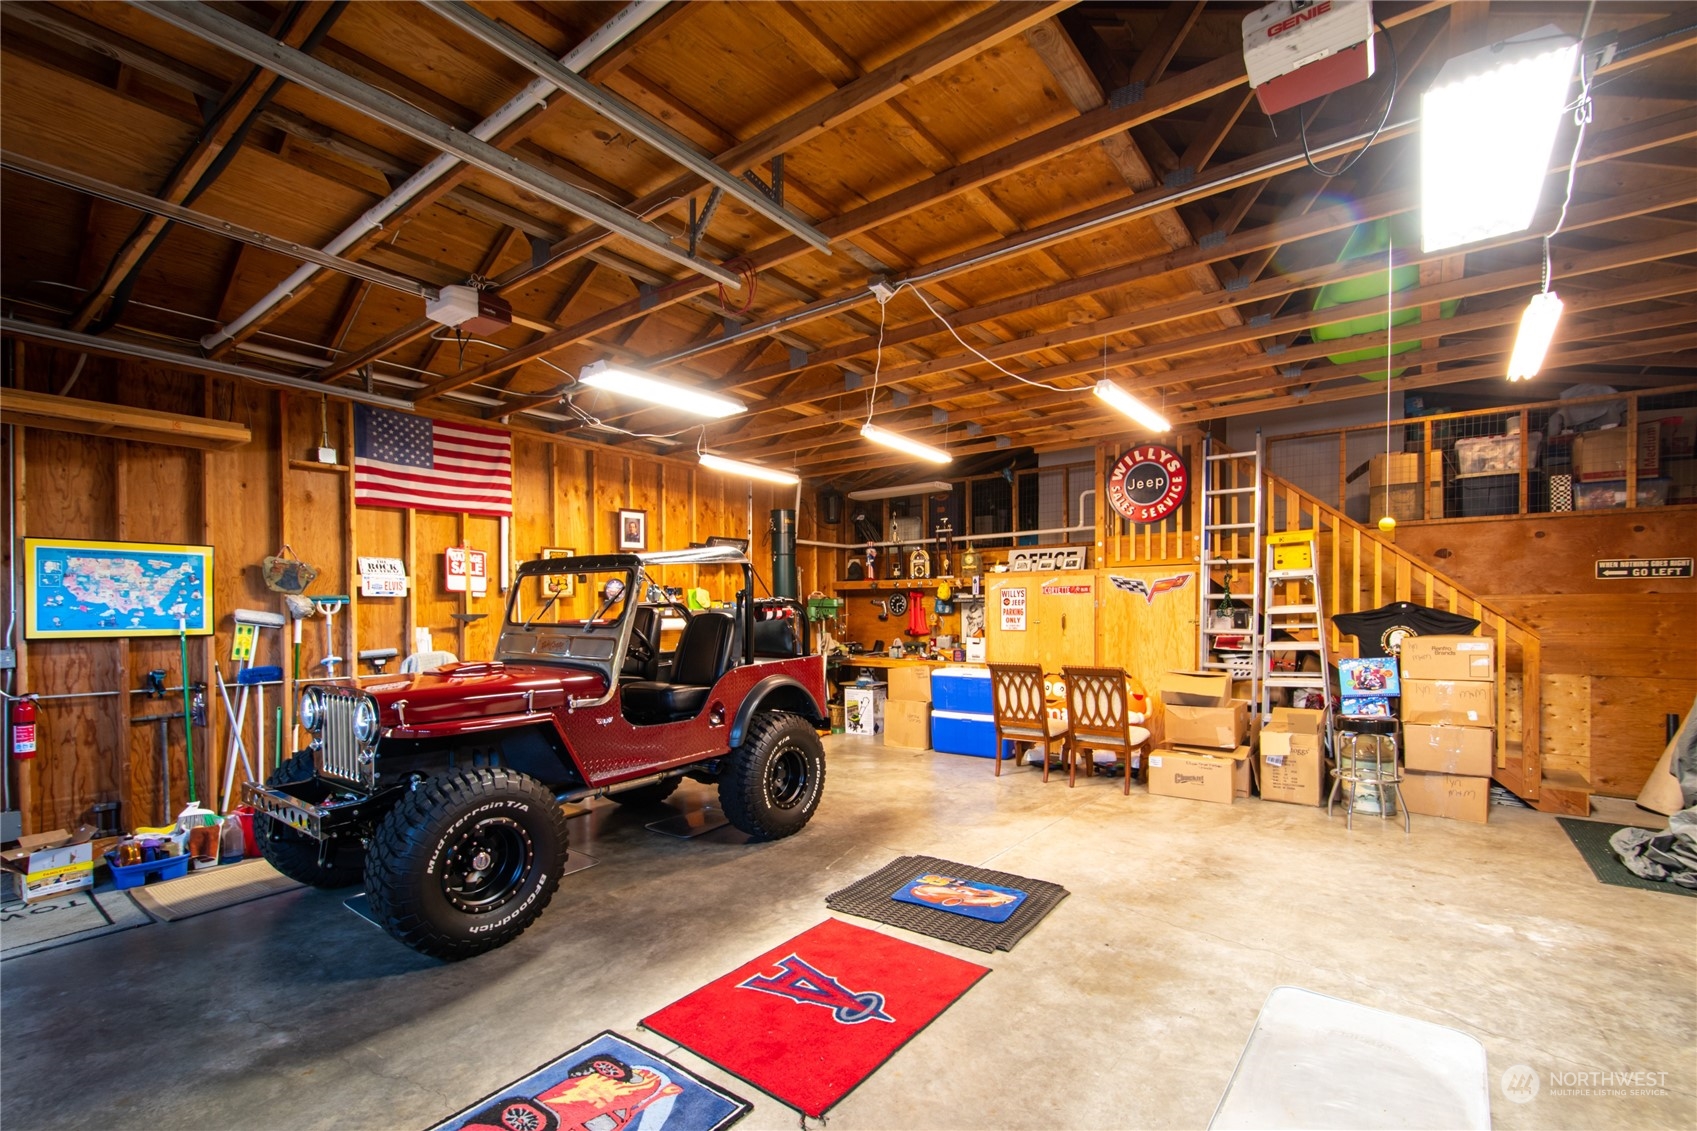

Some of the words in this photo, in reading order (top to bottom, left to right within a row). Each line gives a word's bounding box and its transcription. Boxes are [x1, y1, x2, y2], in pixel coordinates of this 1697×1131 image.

[1267, 1, 1332, 38] GENIE
[1643, 426, 1657, 468] Medium
[1111, 447, 1181, 481] WILLYS
[1127, 477, 1165, 490] Jeep
[1111, 485, 1135, 516] SALES
[1141, 475, 1183, 519] SERVICE
[367, 563, 398, 571] ROCK
[1632, 568, 1649, 577] GO
[1651, 567, 1683, 576] LEFT
[384, 580, 404, 591] ELVIS
[1001, 590, 1025, 598] WILLYS
[1003, 608, 1024, 616] PARKING
[426, 801, 504, 875] Mud-Terrain
[507, 800, 530, 813] T/A
[469, 874, 547, 934] BFGoodrich
